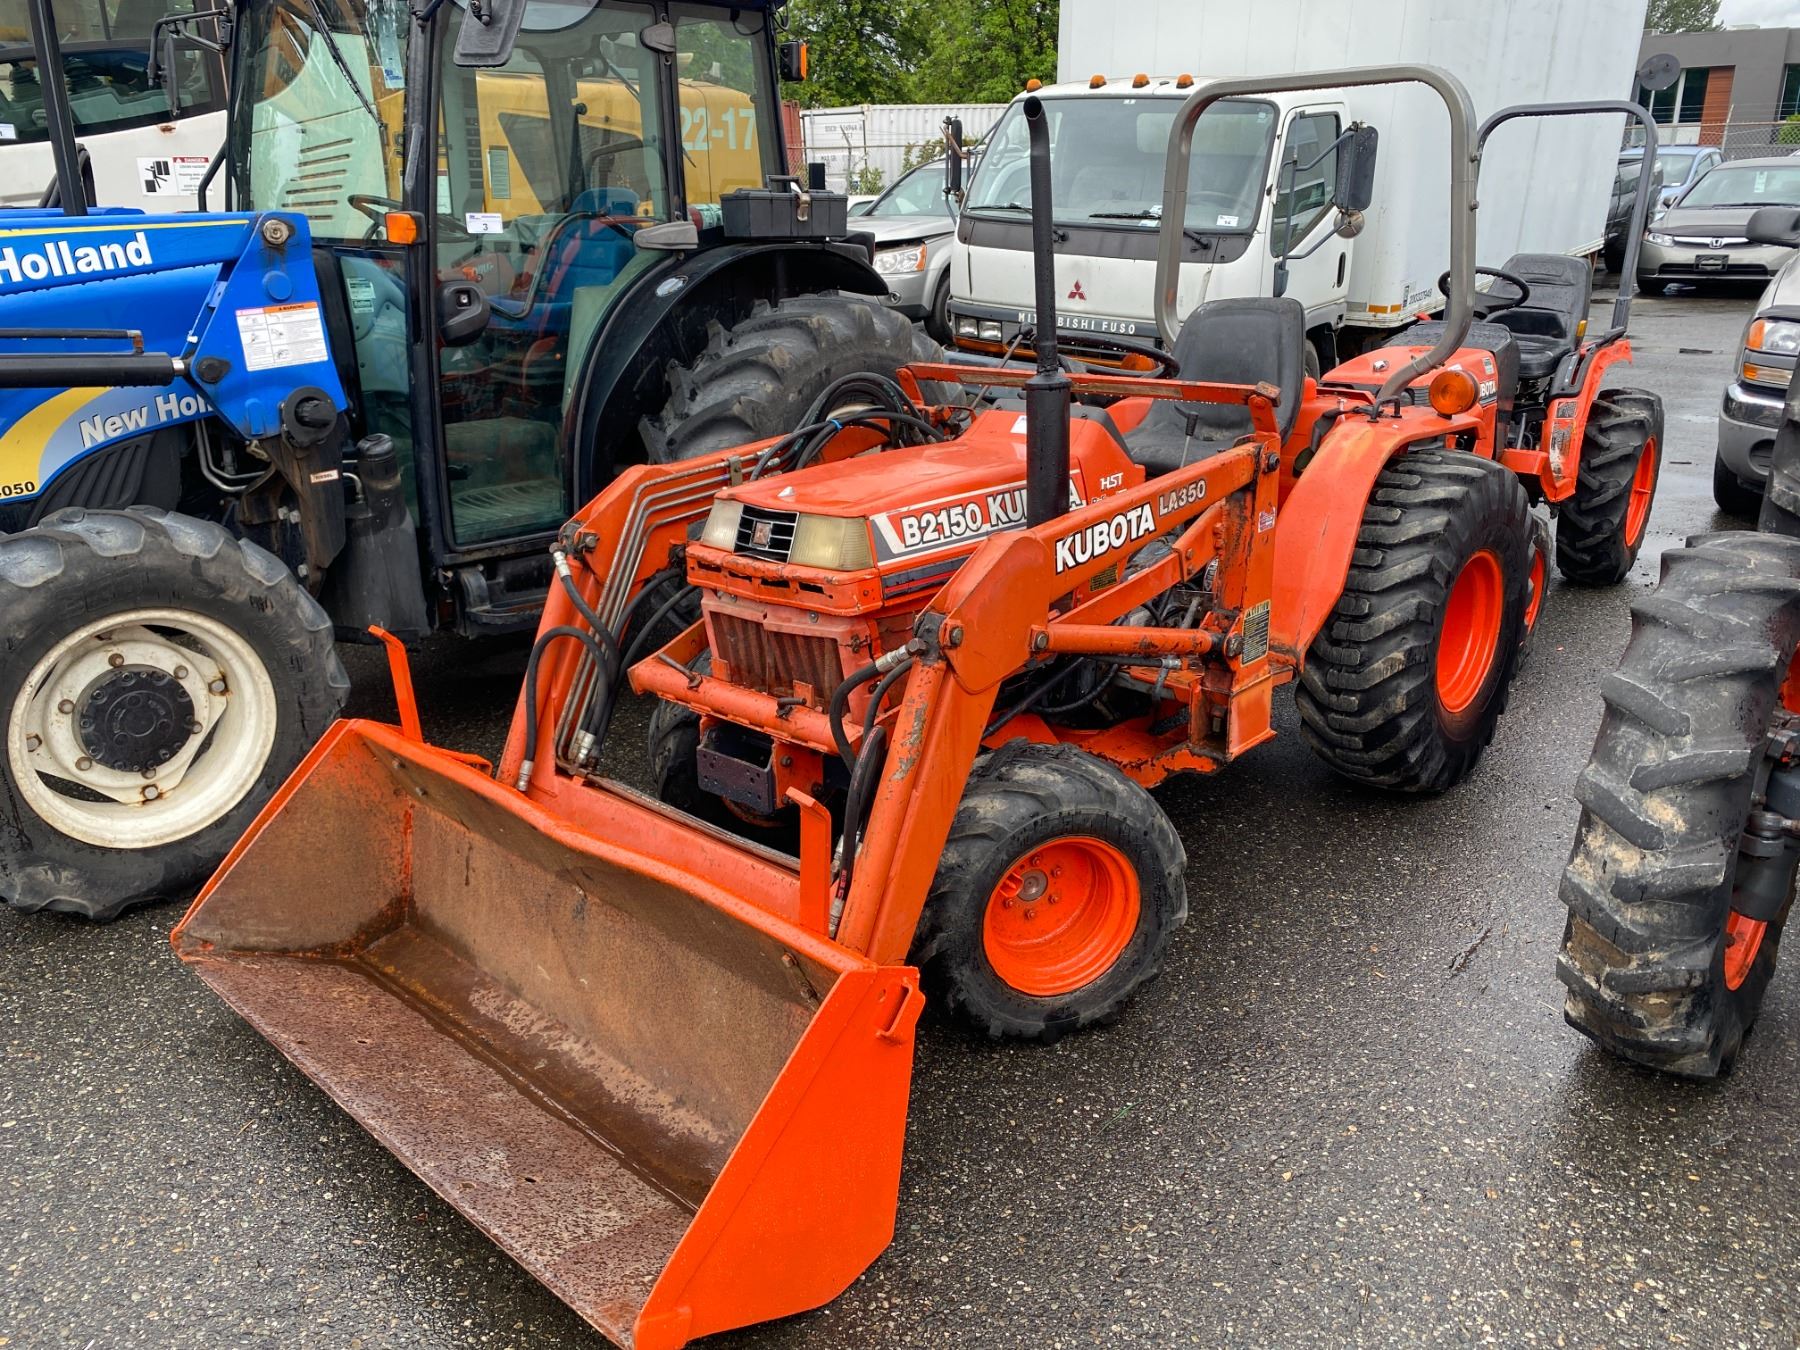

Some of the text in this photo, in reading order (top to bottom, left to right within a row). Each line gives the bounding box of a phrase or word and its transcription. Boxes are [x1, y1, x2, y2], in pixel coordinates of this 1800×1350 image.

[483, 223, 489, 231] 3
[0, 231, 153, 284] Holland
[1018, 312, 1136, 335] MITBISHI FUSO
[1480, 381, 1496, 397] BOTA
[79, 405, 149, 449] New
[0, 481, 36, 496] 050
[1101, 472, 1125, 490] HST
[901, 478, 1083, 549] B2150 KUA
[1056, 479, 1207, 574] KUBOTA LA350
